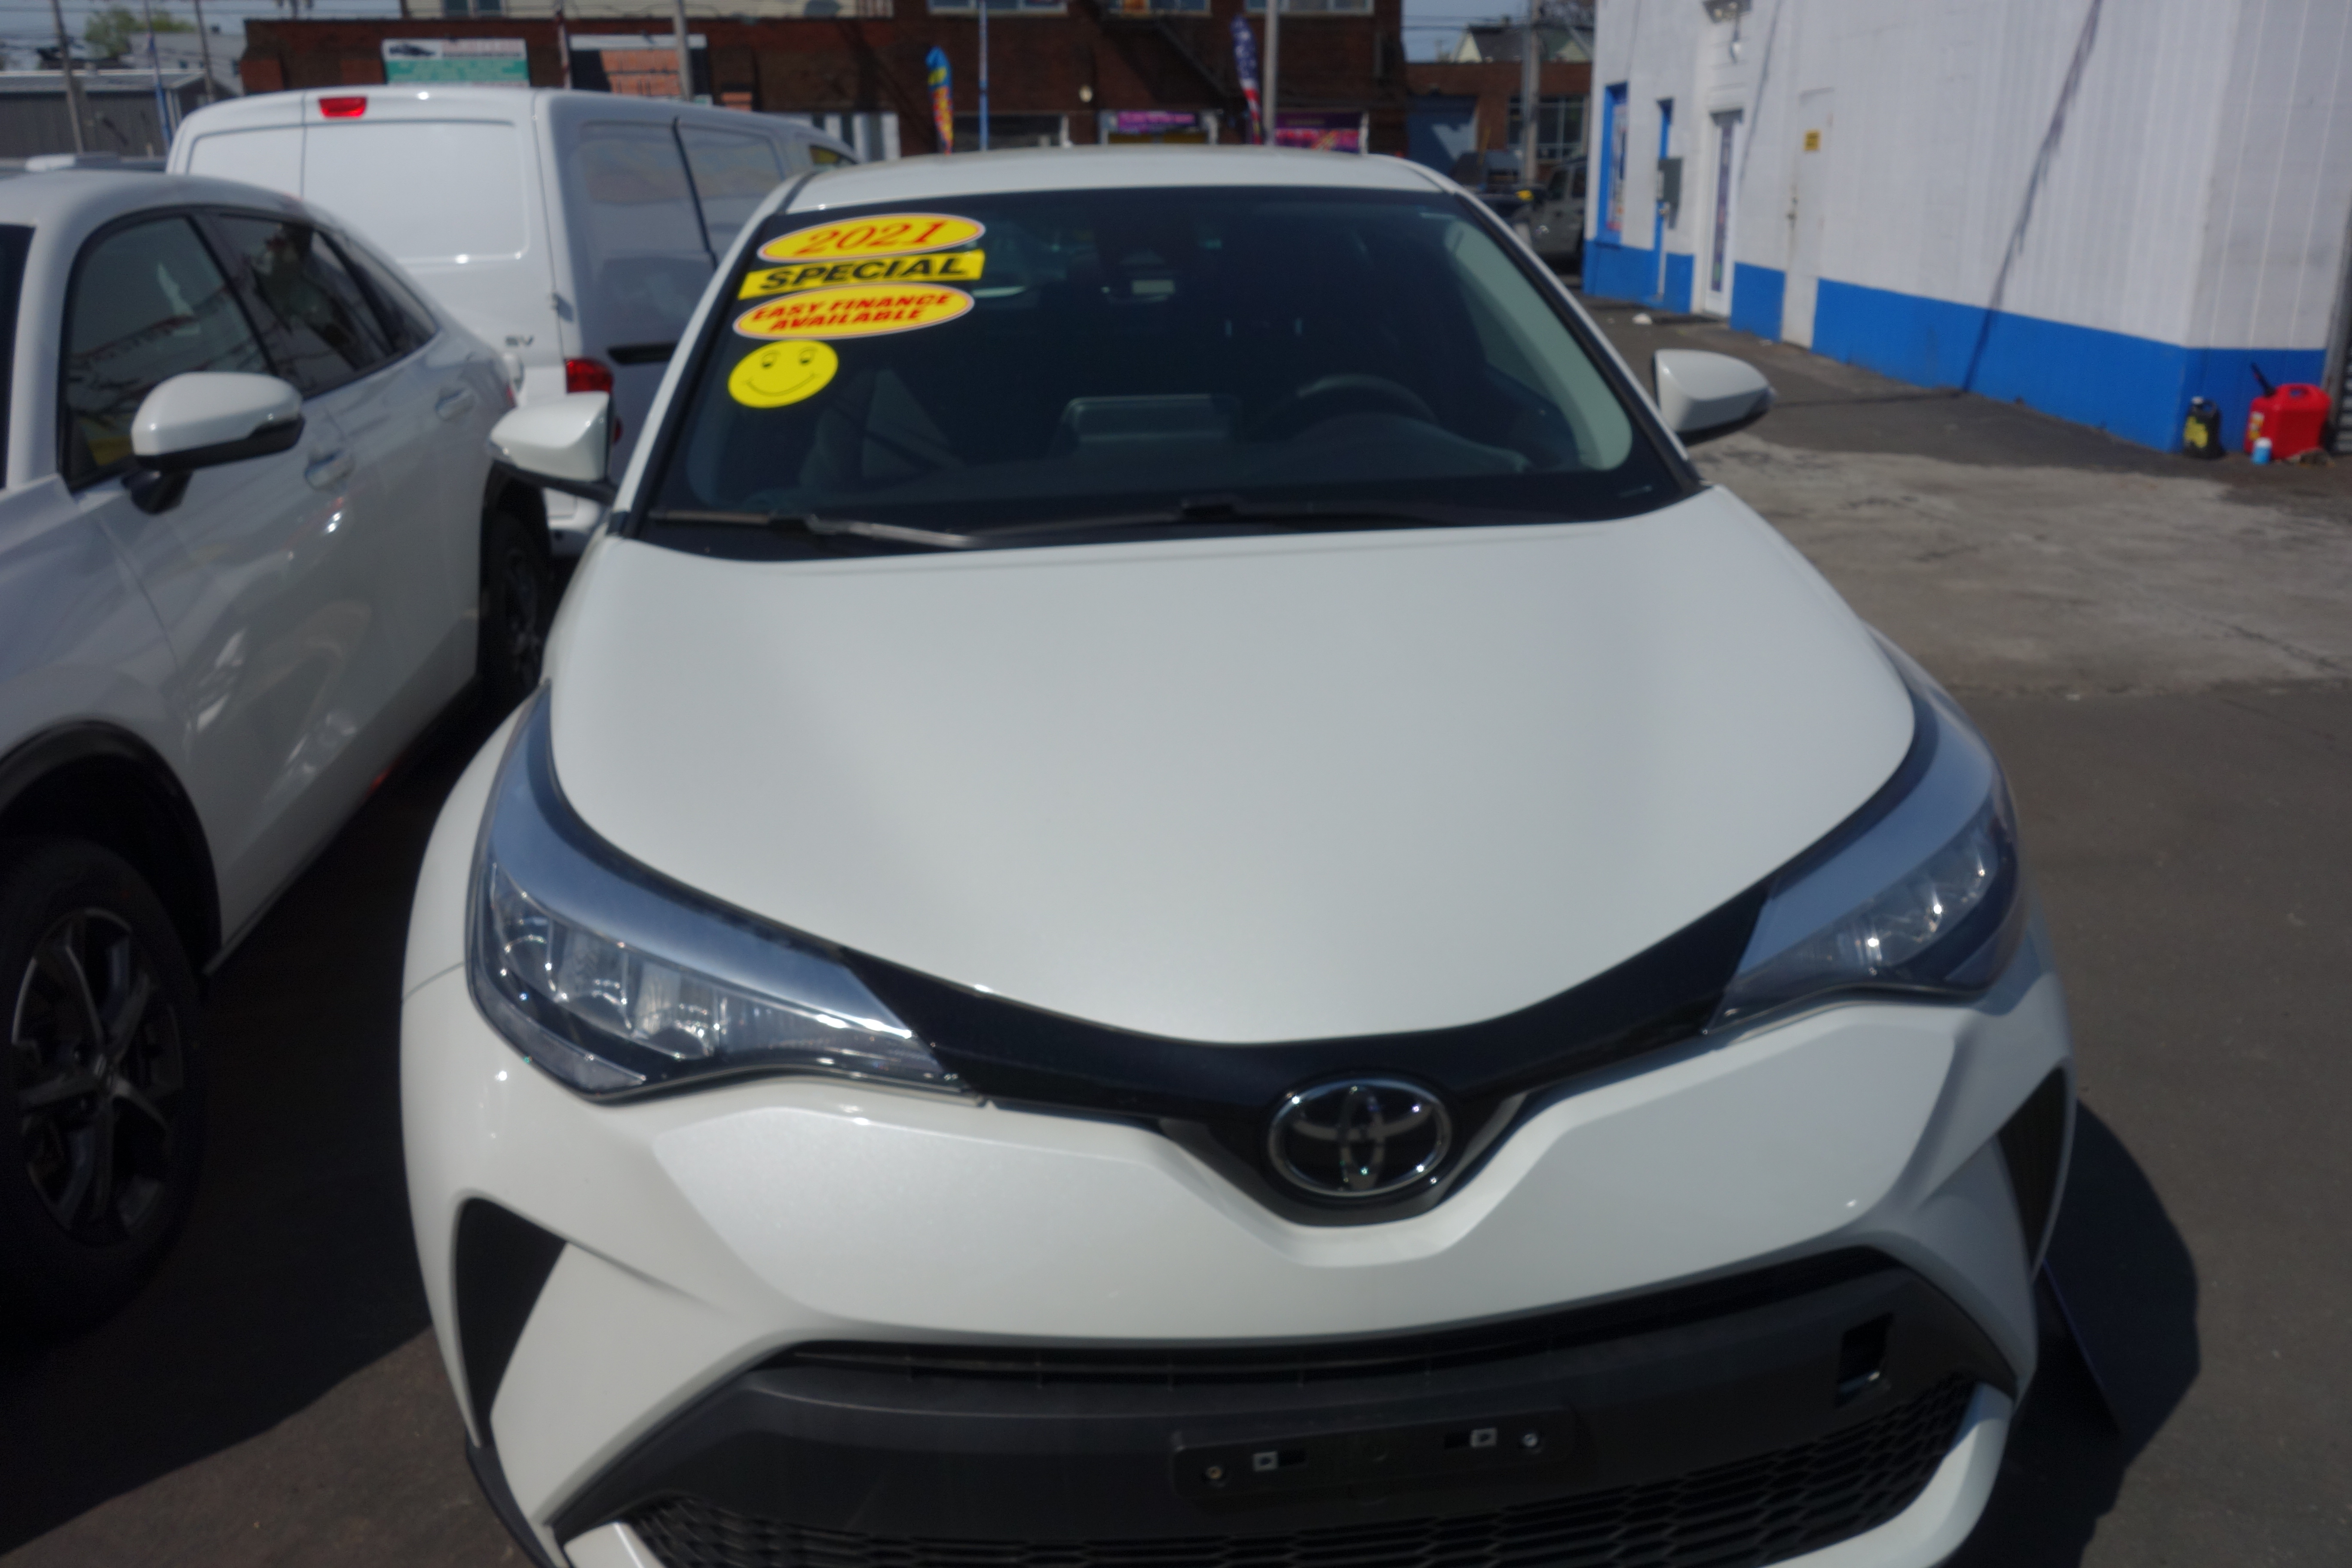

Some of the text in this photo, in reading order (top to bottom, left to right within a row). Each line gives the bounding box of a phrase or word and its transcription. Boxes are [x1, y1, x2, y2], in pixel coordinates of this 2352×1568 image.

[795, 220, 947, 255] 2021
[760, 257, 965, 291] SPECIAL
[752, 293, 950, 321] EASY FINANCE
[769, 309, 924, 331] AVAILABLE
